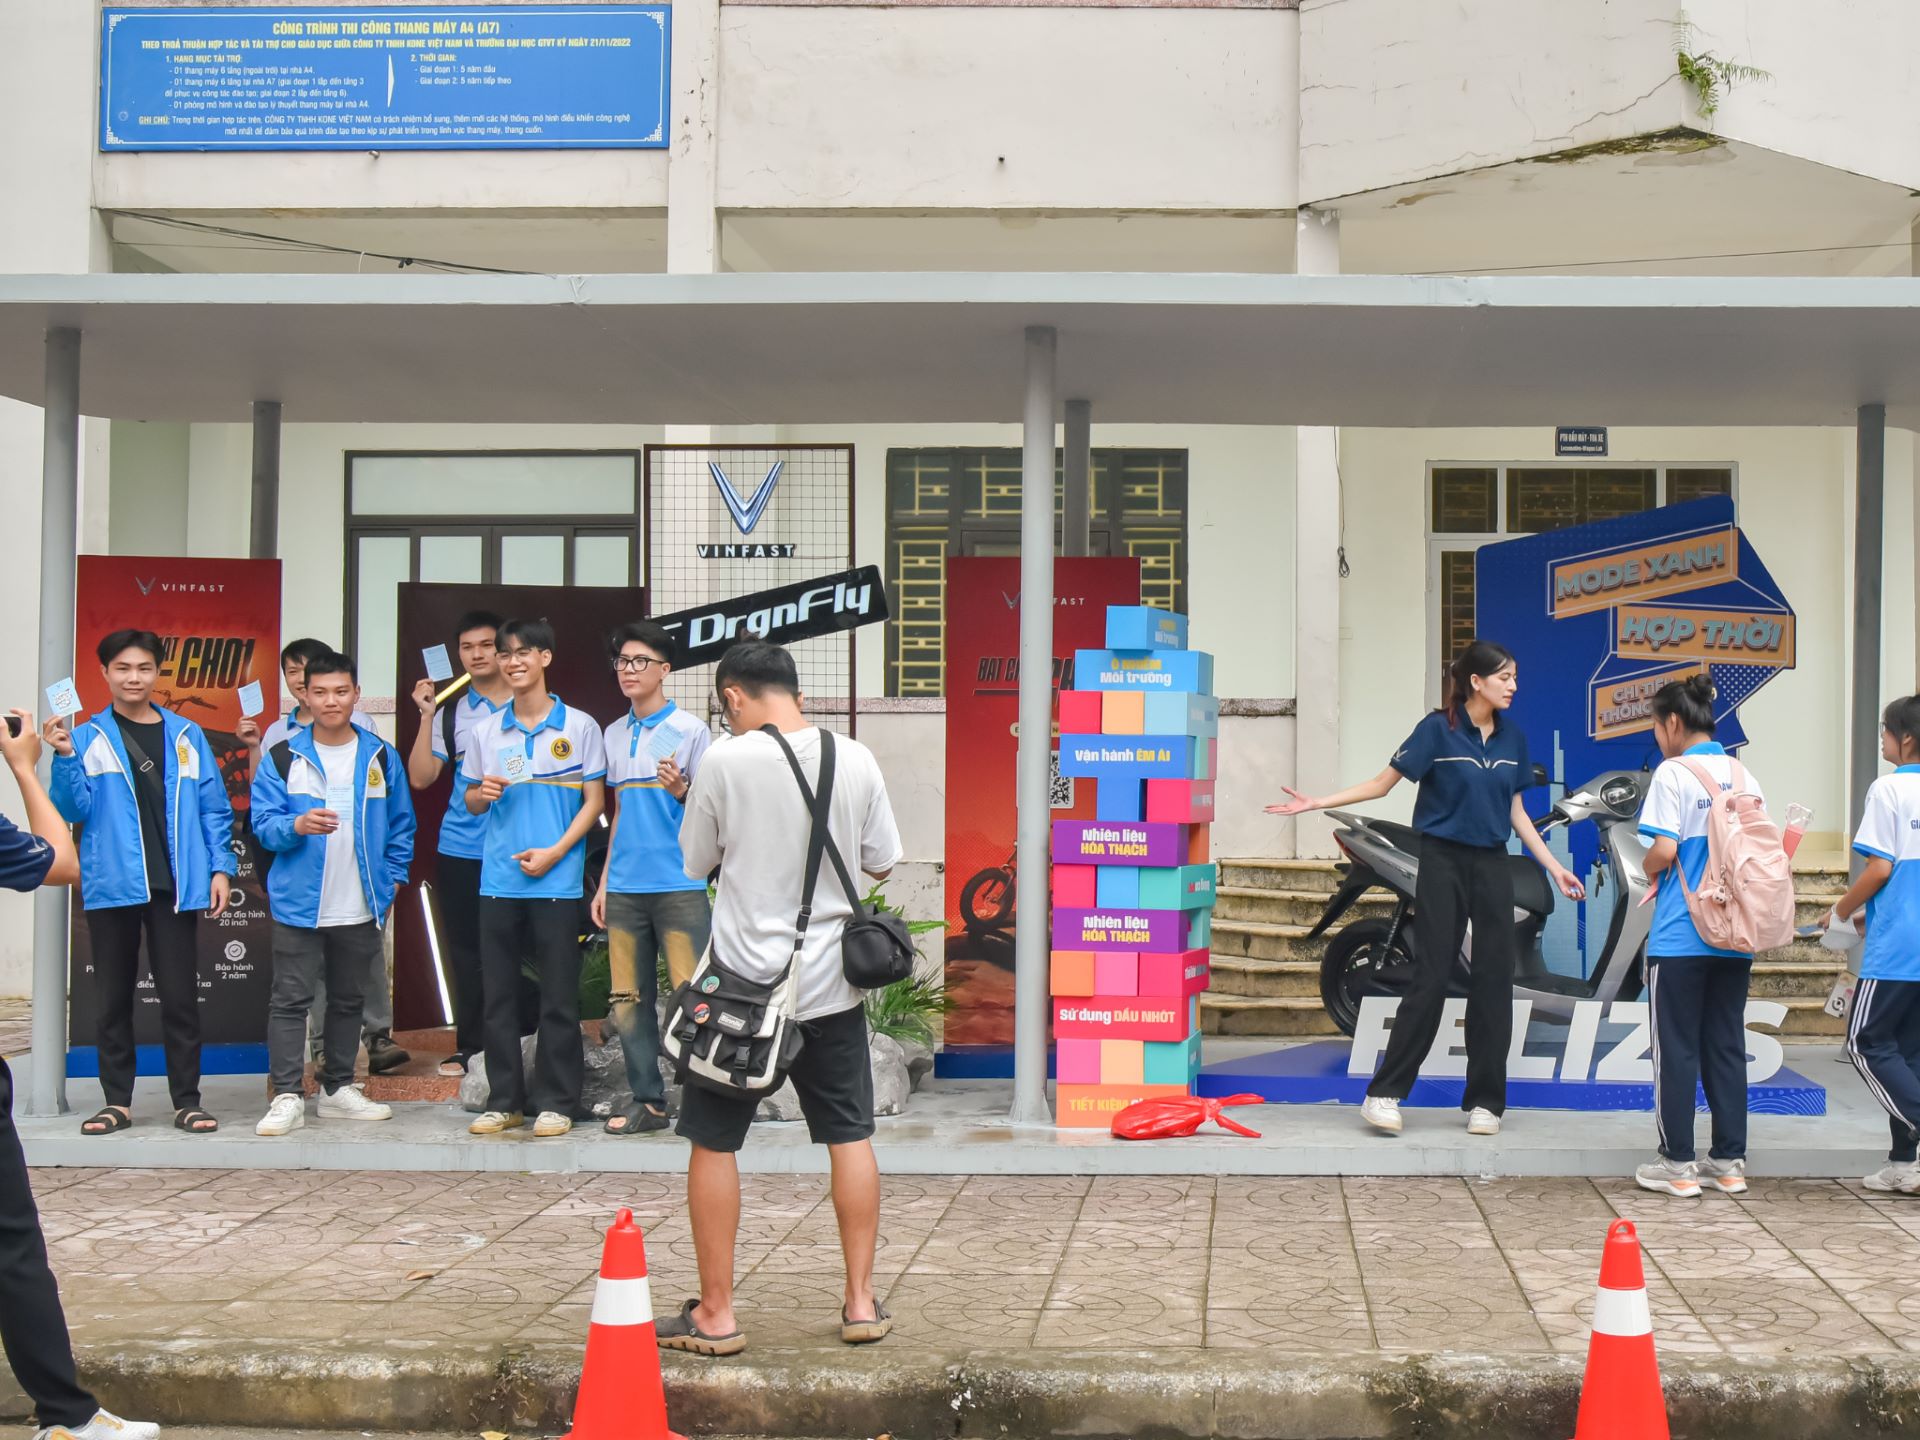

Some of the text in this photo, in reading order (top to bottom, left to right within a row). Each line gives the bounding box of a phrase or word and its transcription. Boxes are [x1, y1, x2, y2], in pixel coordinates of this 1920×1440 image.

[273, 20, 500, 35] CÔNG TRÌNH THI CÔNG THANG MÁY A4 (A7)
[698, 545, 794, 557] VINFAST
[1557, 543, 1725, 600] MODE XANH
[162, 584, 225, 592] VINFAST
[688, 583, 871, 648] DrgnFly
[1620, 615, 1783, 651] HỢP THỜI
[1100, 671, 1172, 687] Môi trường
[1613, 684, 1639, 704] CHI
[1074, 749, 1099, 764] Vận
[1101, 748, 1134, 762] hành
[1082, 828, 1147, 844] Nhiên liệu
[1081, 842, 1148, 857] HÓA THẠCH
[1084, 916, 1149, 931] Nhiên liệu
[1082, 930, 1150, 944] HÓA THẠCH
[1079, 1008, 1112, 1025] dụng
